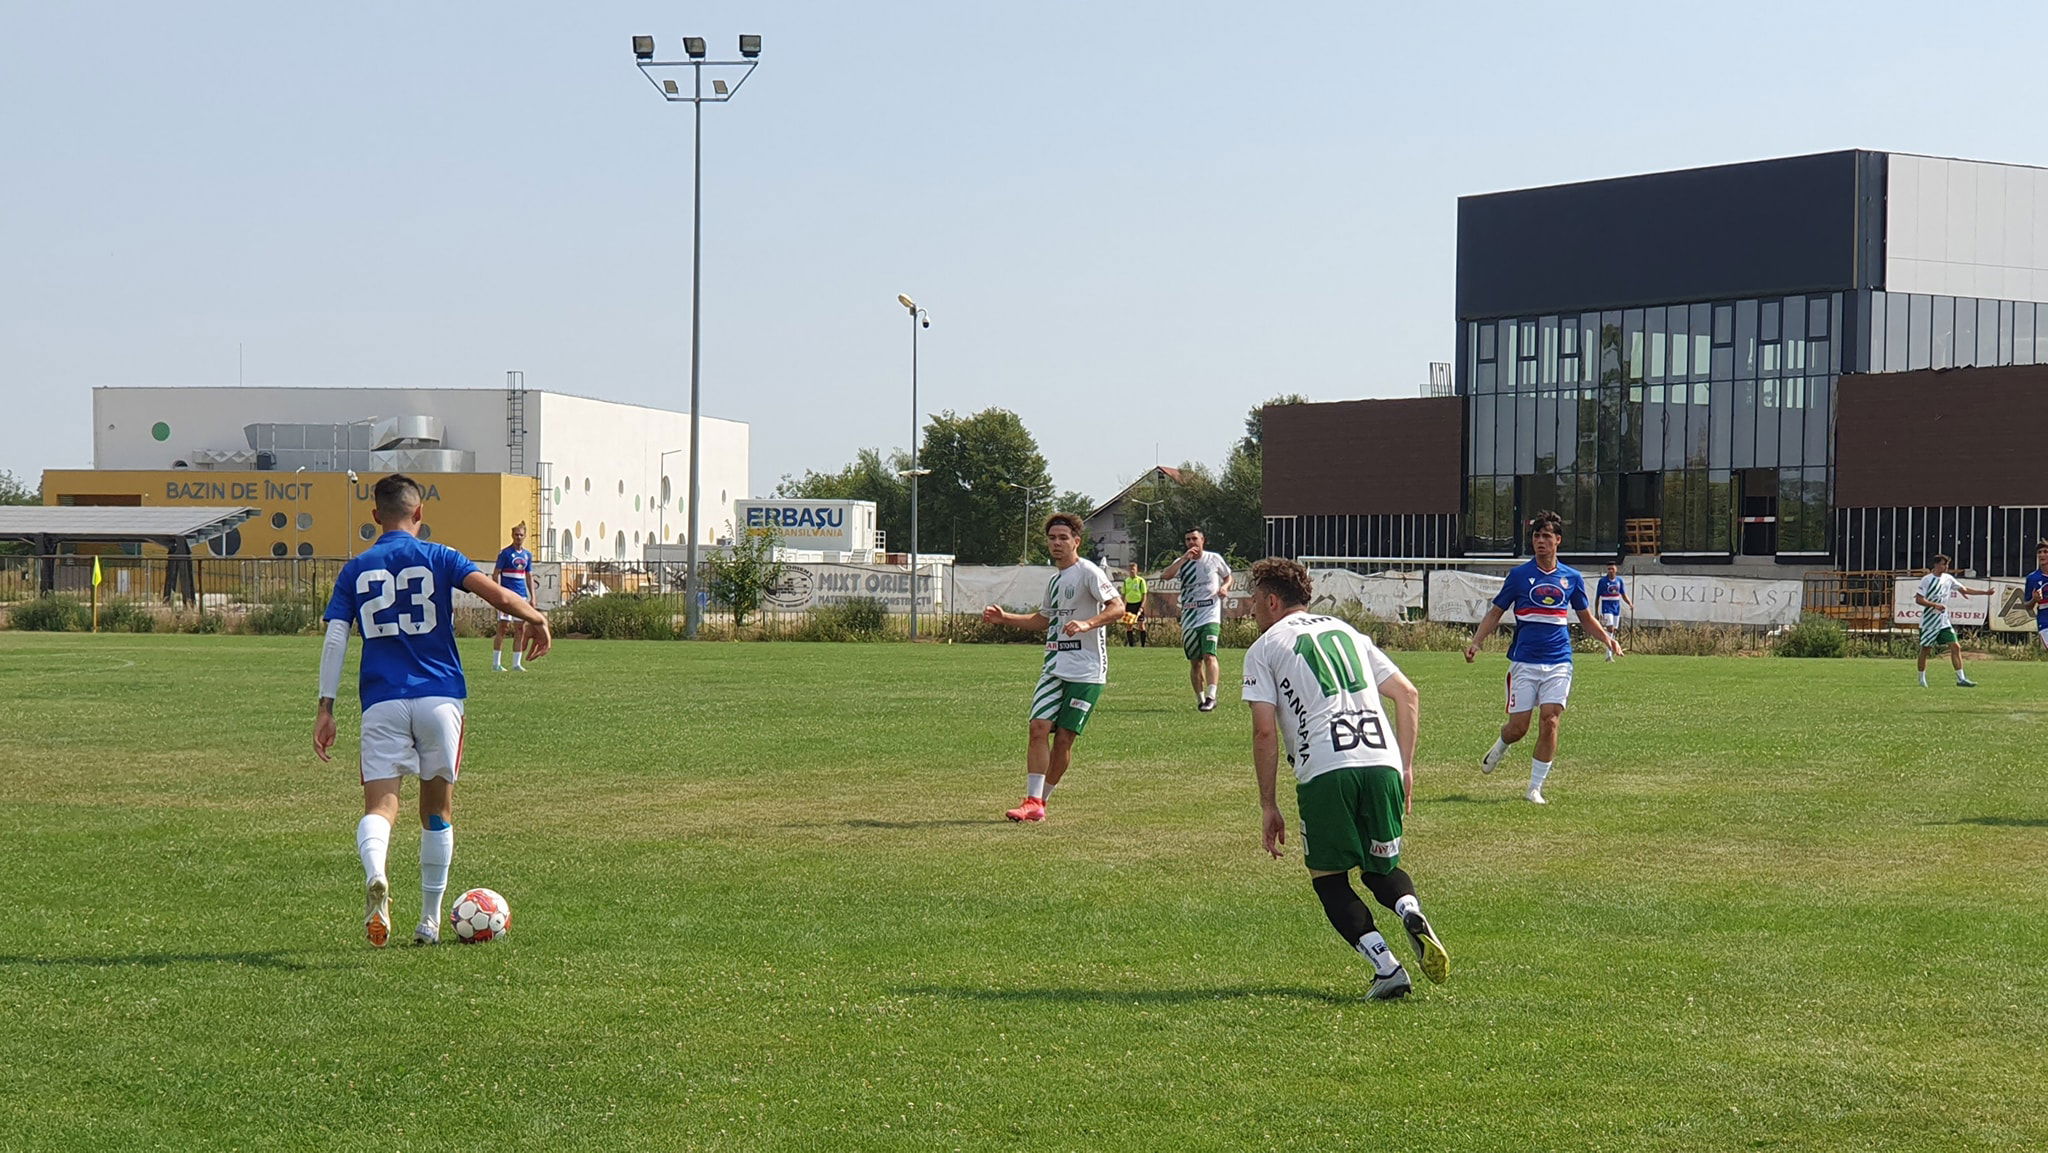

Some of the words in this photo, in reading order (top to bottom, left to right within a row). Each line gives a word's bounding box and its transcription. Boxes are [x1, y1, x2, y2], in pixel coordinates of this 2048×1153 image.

[166, 482, 225, 499] BAZIN
[231, 483, 258, 499] DE
[777, 528, 843, 537] RANSILVANIA
[818, 573, 861, 592] MIXT
[356, 566, 437, 639] 23
[1640, 584, 1798, 606] NOKIPLAST
[1897, 610, 1985, 619] ACISURI
[1292, 630, 1368, 698] 10
